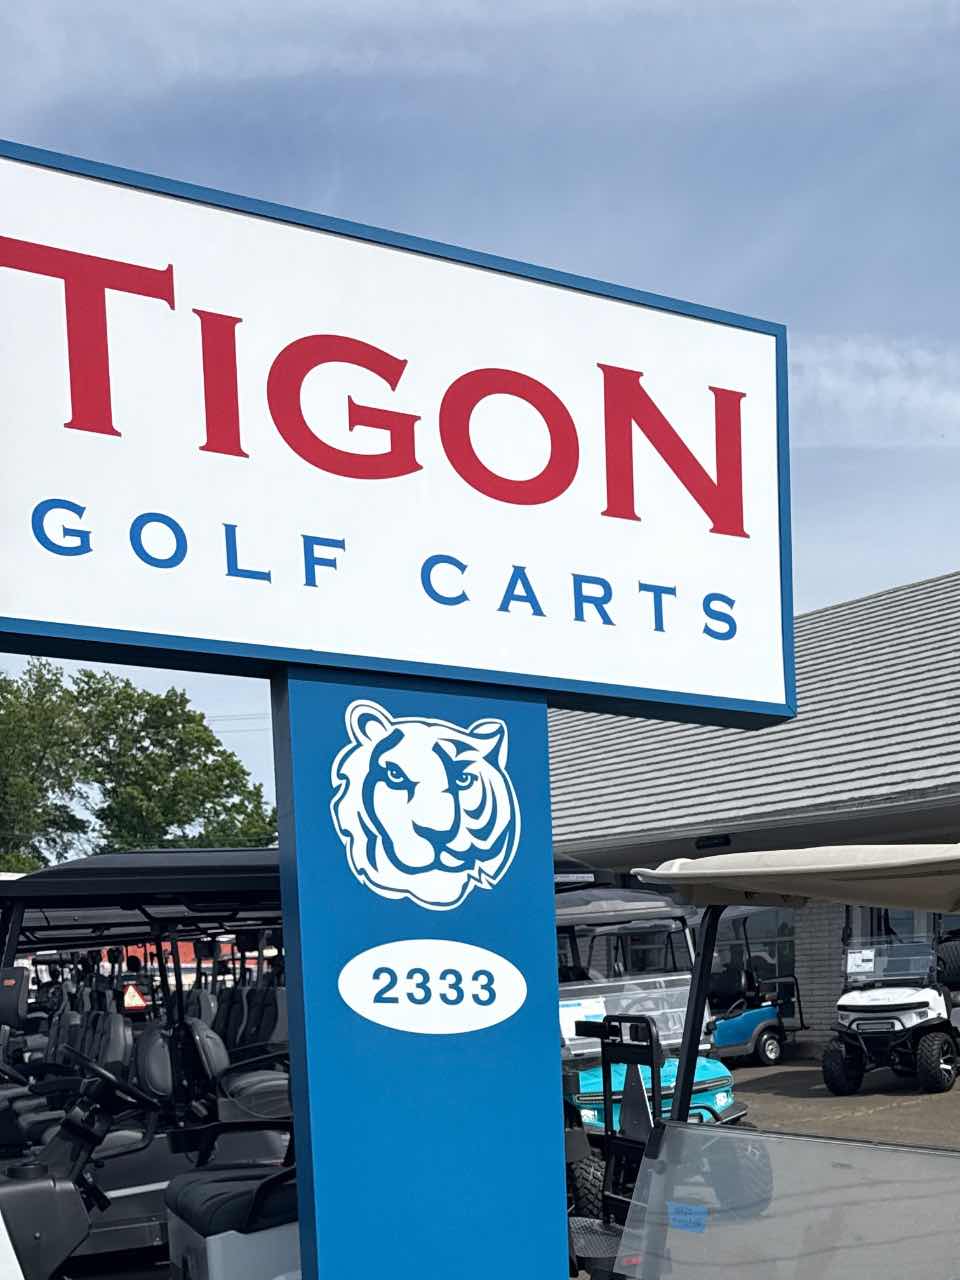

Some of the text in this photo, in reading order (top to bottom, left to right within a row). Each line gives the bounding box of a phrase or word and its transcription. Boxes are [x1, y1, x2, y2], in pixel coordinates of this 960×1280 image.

[0, 235, 750, 539] TIGON
[31, 497, 738, 641] GOLF CARTS
[372, 966, 497, 1006] 2333
